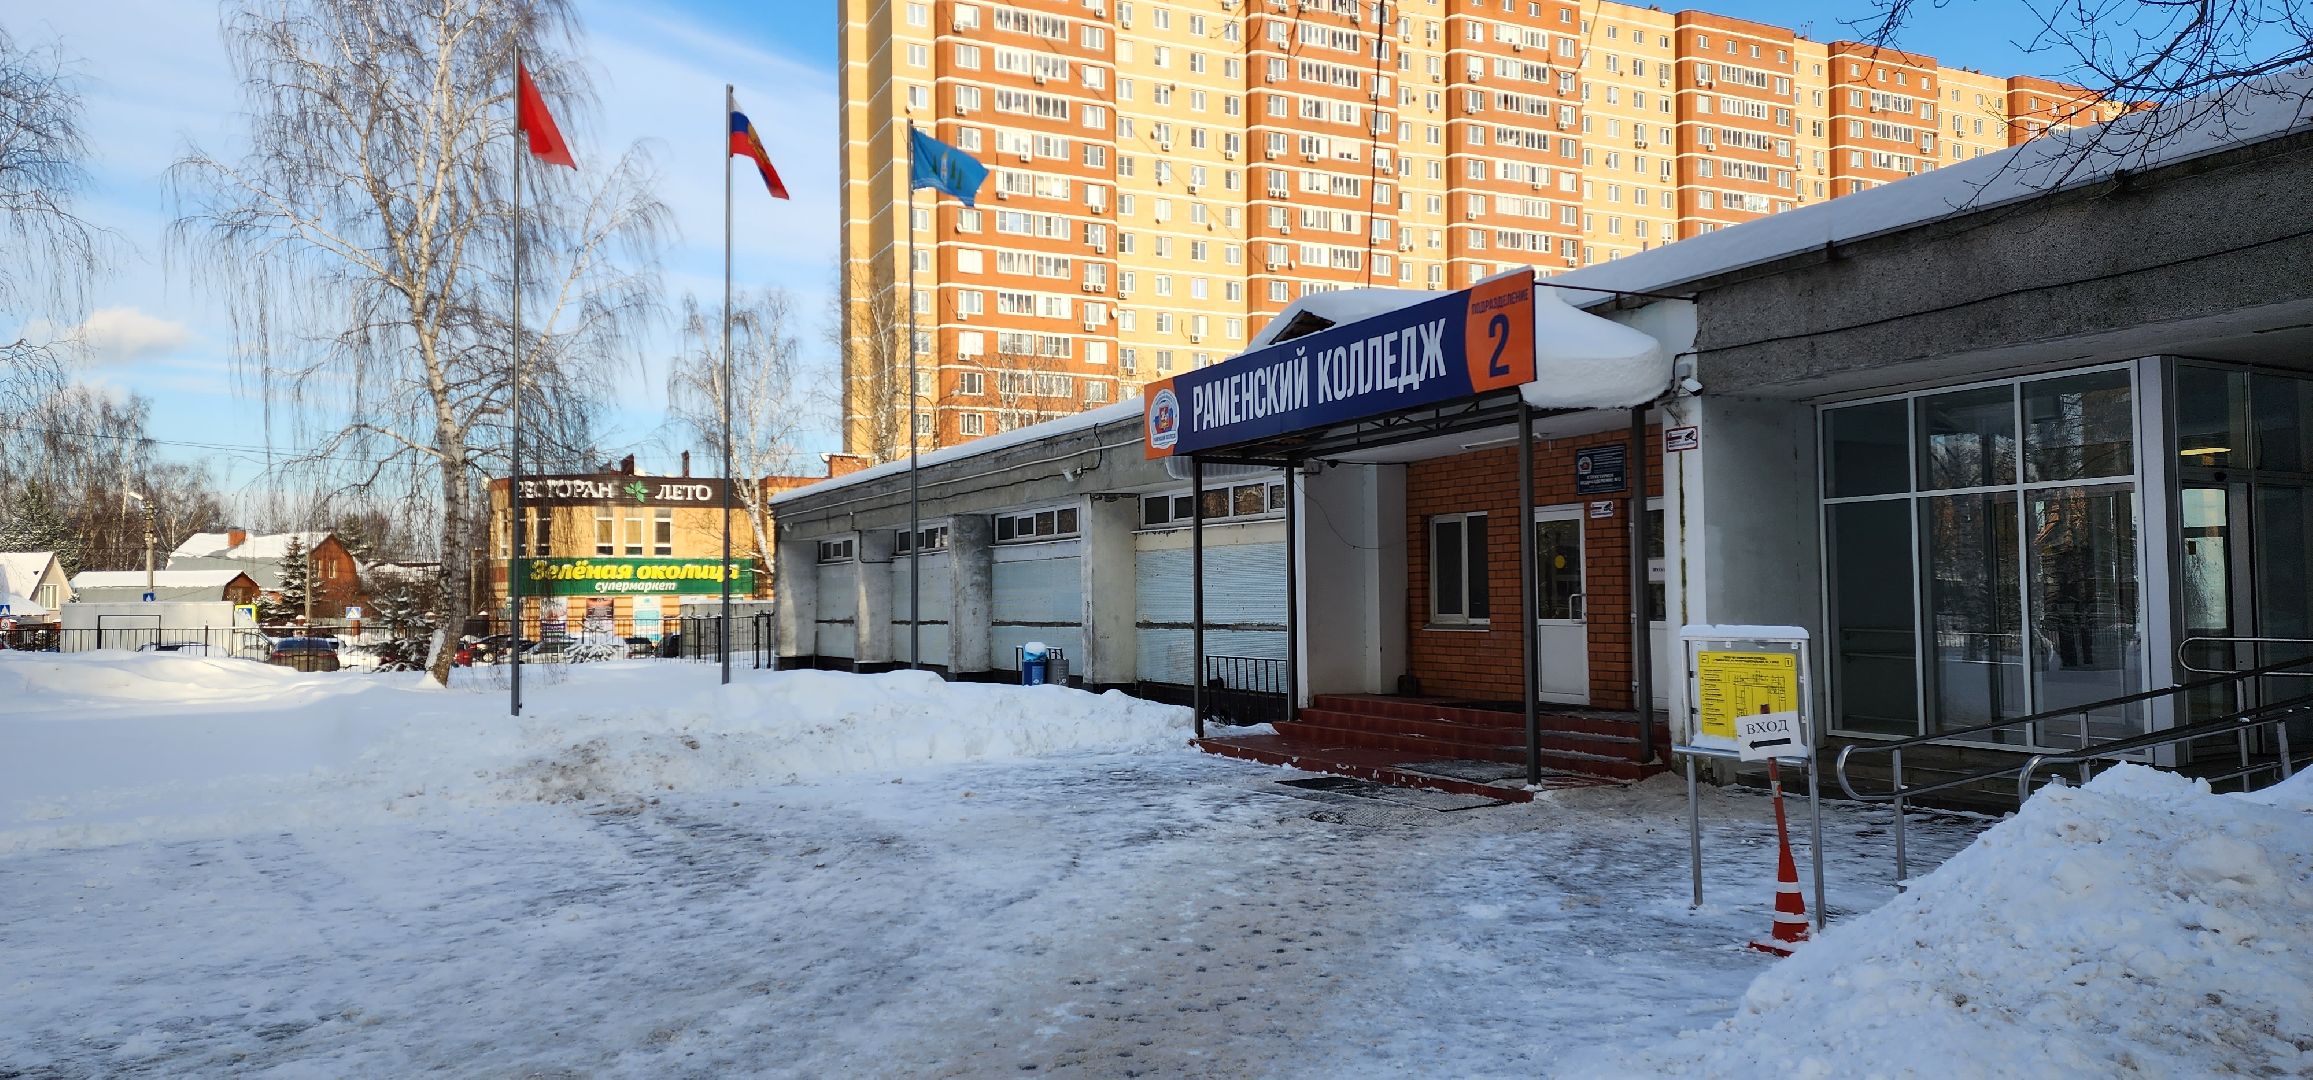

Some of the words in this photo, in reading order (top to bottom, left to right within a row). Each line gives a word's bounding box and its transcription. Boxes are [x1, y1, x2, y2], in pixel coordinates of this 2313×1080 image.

[1471, 288, 1529, 315] ПОДРАЗДЕЛЕНИЕ
[1488, 312, 1510, 379] 2
[1192, 345, 1309, 433] РАМЕНСКИЙ
[1317, 317, 1447, 405] КОЛЛЕДЖ
[654, 484, 713, 501] ЛЕТО
[594, 580, 676, 592] супермаркет
[1746, 719, 1790, 735] ВХОД
